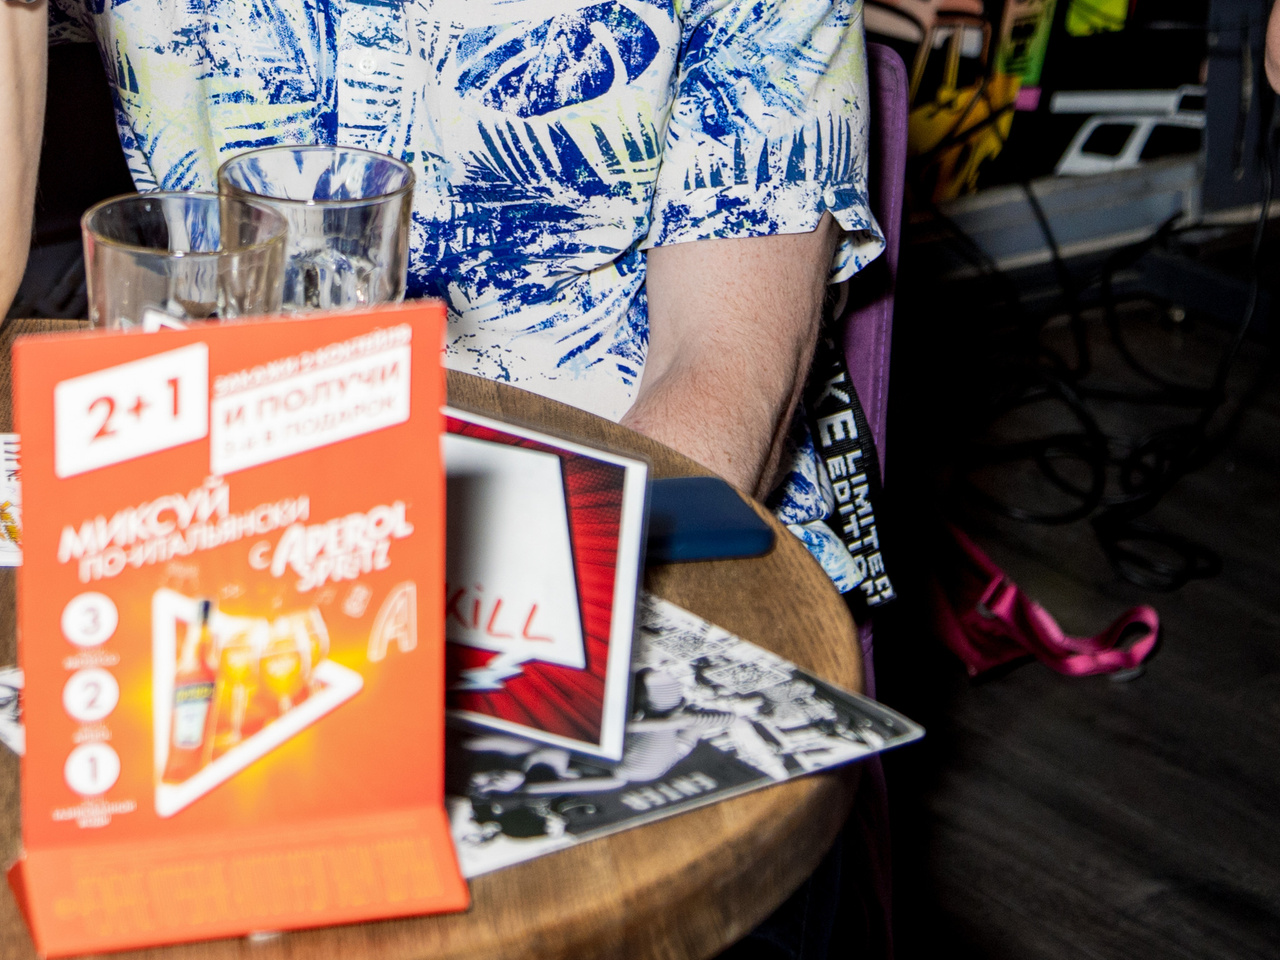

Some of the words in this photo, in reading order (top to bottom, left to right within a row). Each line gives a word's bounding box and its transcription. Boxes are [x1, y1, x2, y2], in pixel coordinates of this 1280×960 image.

[256, 358, 401, 420] ПОЛУЧИ
[59, 475, 230, 563] МИКСУЙ
[270, 499, 414, 578] APEROL
[80, 607, 102, 637] 3
[81, 681, 103, 711] 2
